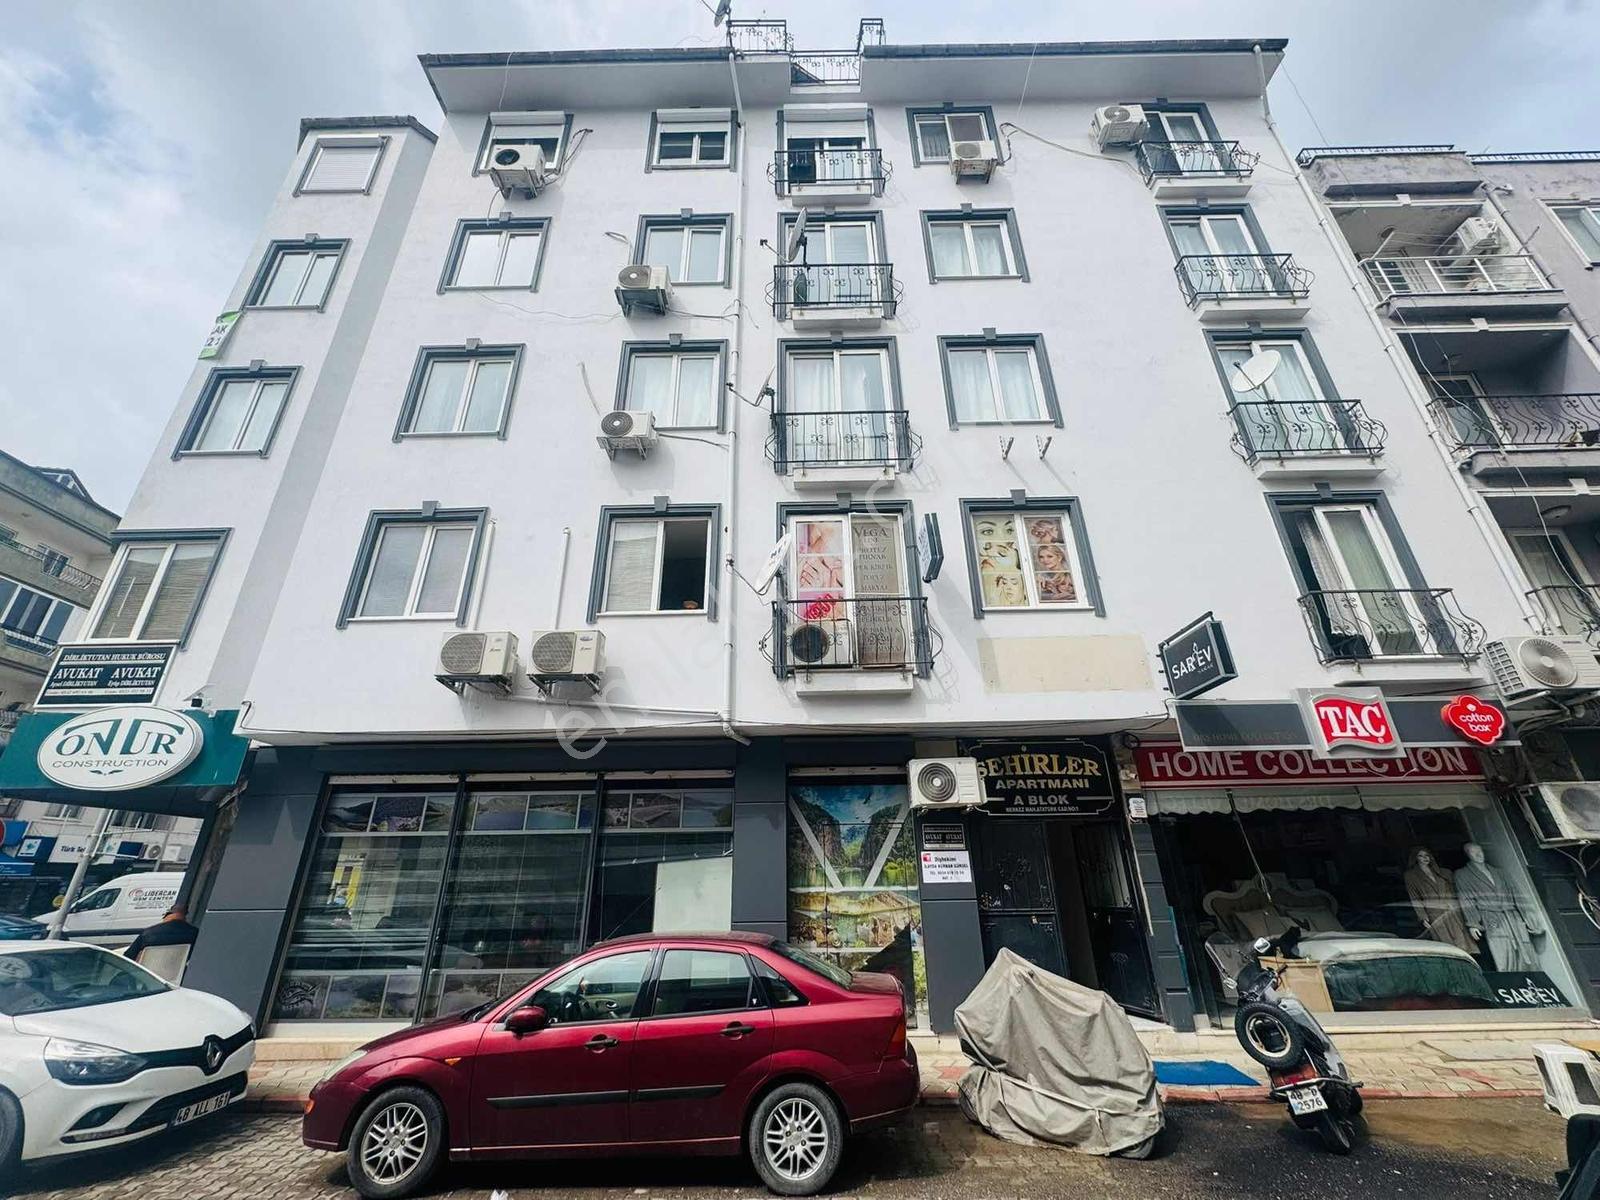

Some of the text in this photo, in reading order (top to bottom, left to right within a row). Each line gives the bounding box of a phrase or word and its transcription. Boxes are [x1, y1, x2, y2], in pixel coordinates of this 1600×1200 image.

[852, 526, 889, 538] VEGA
[111, 653, 137, 661] HUKUK
[54, 667, 161, 679] AVUKAT AVUKAT
[1459, 713, 1494, 722] cotton
[1318, 705, 1387, 743] TAÇ
[1468, 723, 1491, 732] box
[52, 759, 169, 768] CONSTRUCTION
[1150, 748, 1469, 777] HOME COLLECTION
[996, 779, 1089, 789] APARTMANI
[1014, 794, 1070, 805] A BLOK
[1298, 1097, 1323, 1111] 2576
